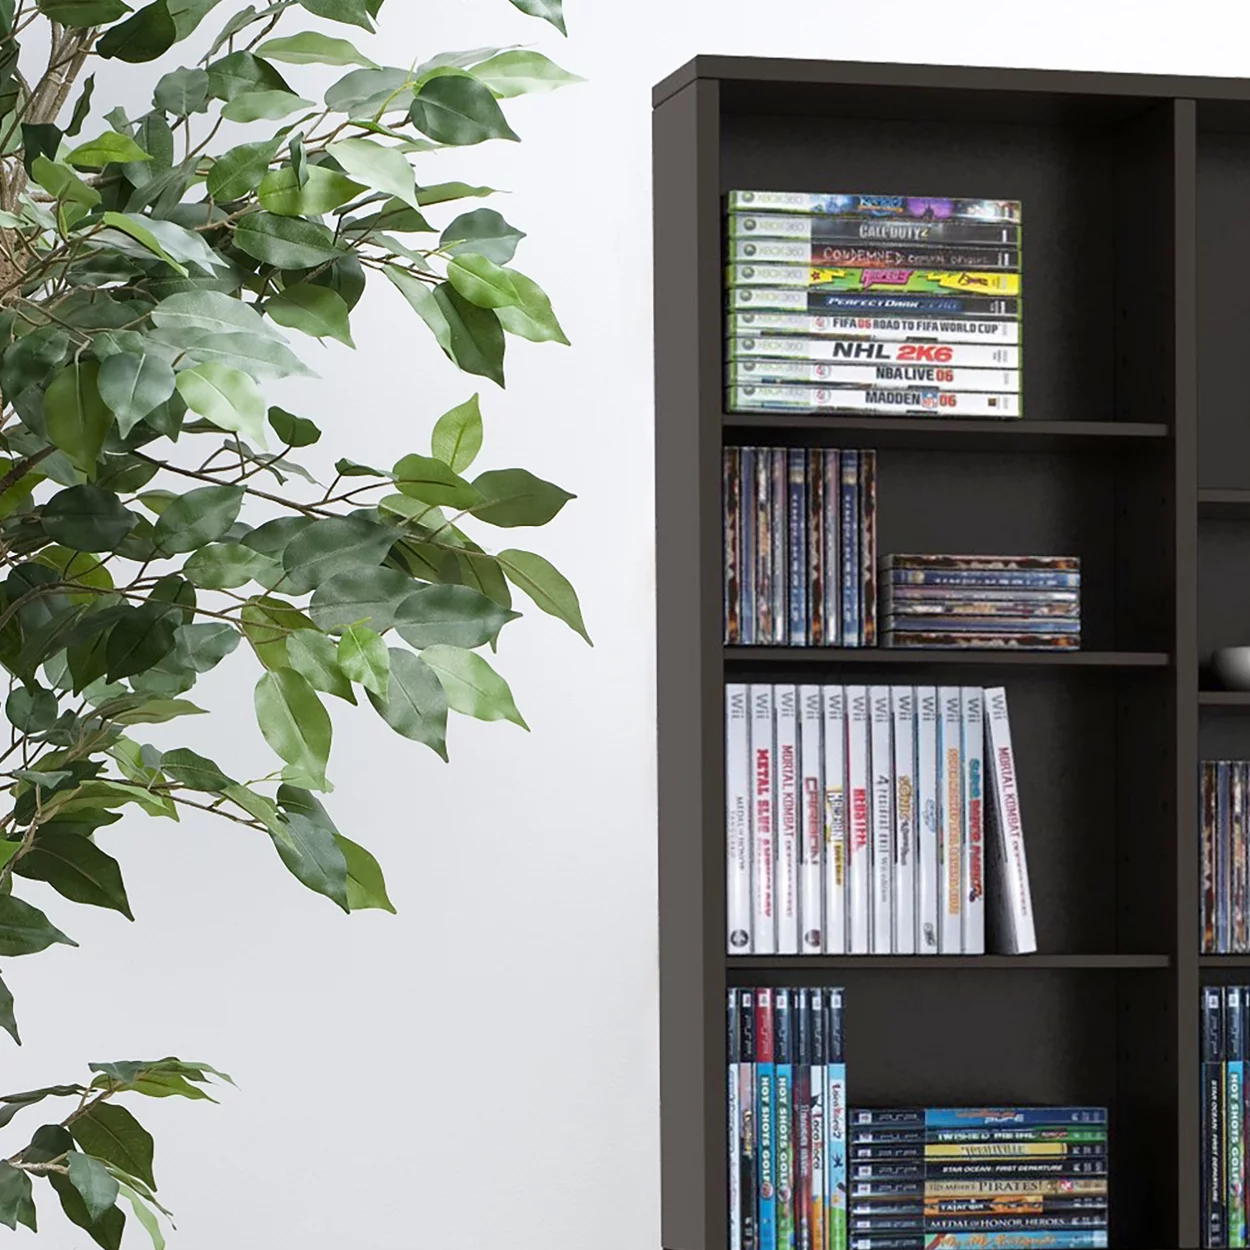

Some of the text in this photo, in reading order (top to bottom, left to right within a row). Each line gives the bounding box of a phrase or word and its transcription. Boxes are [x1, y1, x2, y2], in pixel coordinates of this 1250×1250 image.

[833, 318, 999, 334] FIFA 06 ROAD TO FIFA WORLD CUP
[832, 342, 954, 362] NHL 2K6
[876, 368, 954, 382] NBA LIVE 06
[865, 391, 957, 407] MADDEN 06
[731, 693, 746, 719] Wii
[757, 694, 770, 719] Wii
[806, 695, 821, 720] Wii
[829, 695, 845, 720] Wii
[853, 697, 868, 722] Wii
[899, 695, 914, 721] Wii
[922, 696, 937, 721] Wii
[946, 698, 960, 723] Wii
[757, 749, 770, 795] METAL
[782, 692, 796, 838] Wii MORTAL KOMBAT
[991, 694, 1021, 838] Wii MORTAL KOMBAT
[761, 1077, 772, 1183] HOT SHOTS GOLF
[778, 1077, 788, 1184] HOT SHOTS GOLF
[1231, 1074, 1240, 1181] HOT SHOTS GOLF
